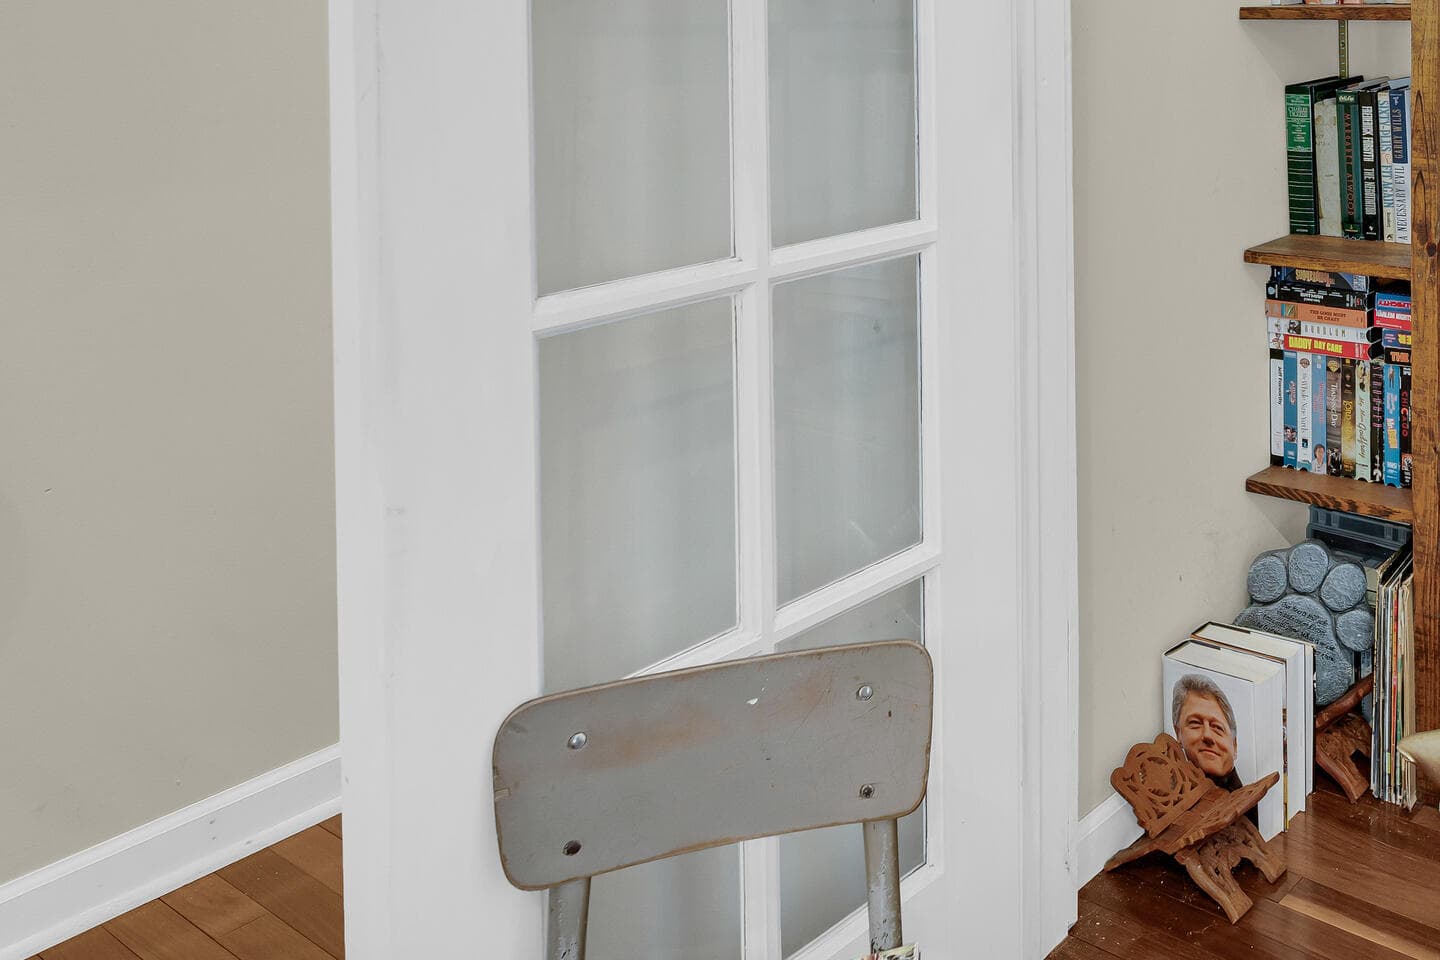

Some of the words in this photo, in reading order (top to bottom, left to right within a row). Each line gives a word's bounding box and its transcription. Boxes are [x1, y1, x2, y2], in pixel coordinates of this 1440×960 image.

[1383, 165, 1392, 179] FIT
[1396, 167, 1404, 185] EVIL
[1383, 181, 1393, 208] AGAIN
[1396, 188, 1406, 231] NECESSARY
[1314, 341, 1326, 349] DAY
[1327, 343, 1342, 353] CARE
